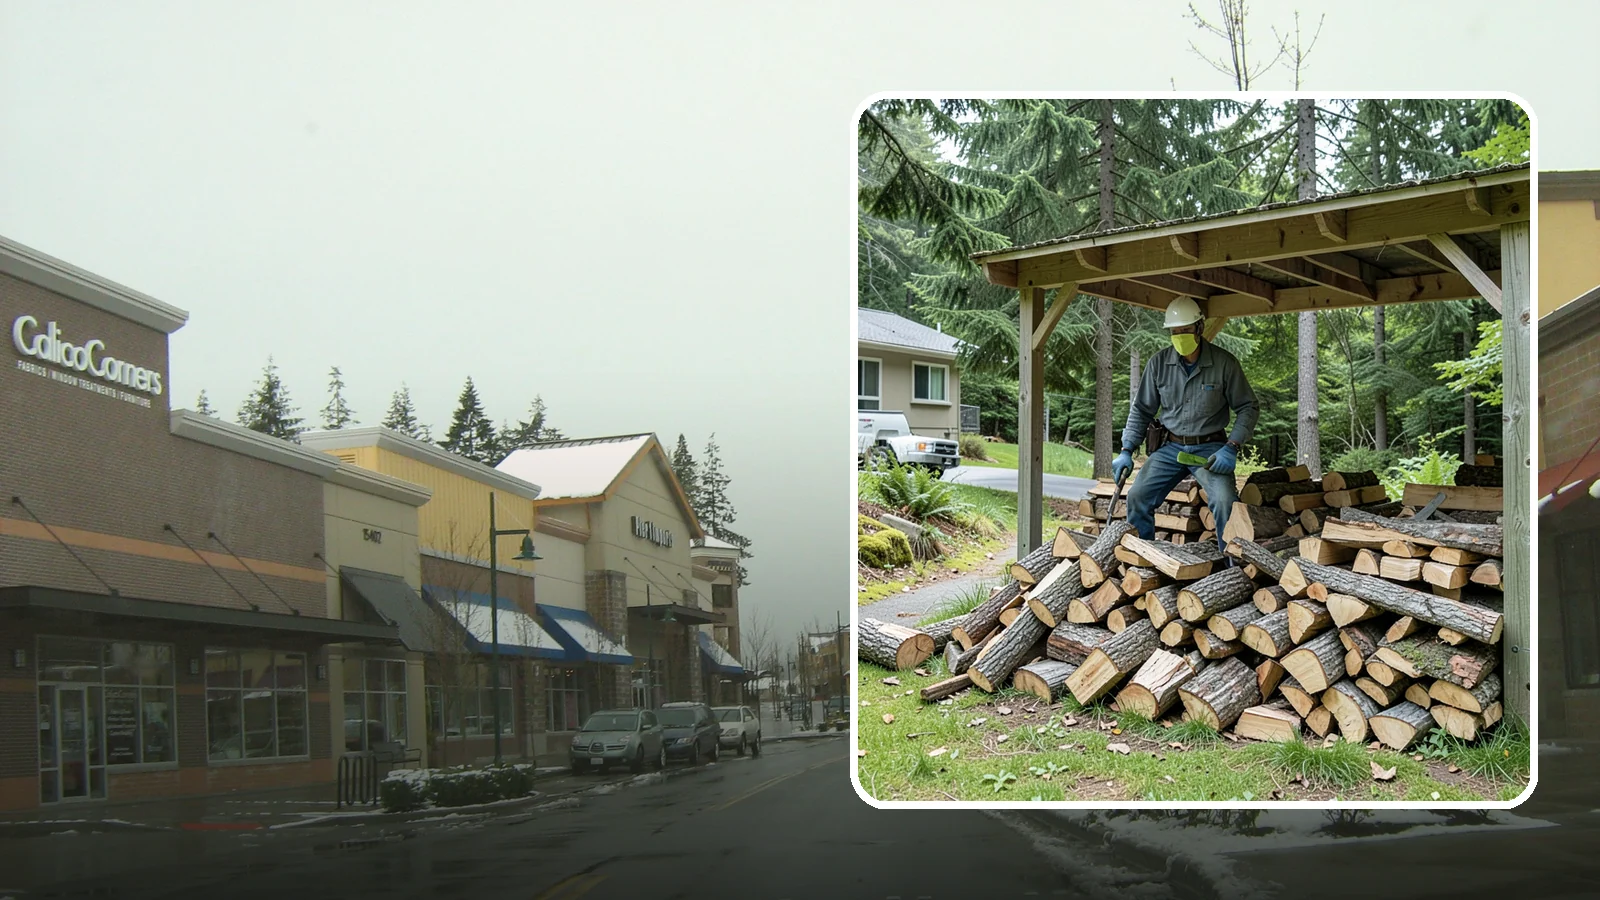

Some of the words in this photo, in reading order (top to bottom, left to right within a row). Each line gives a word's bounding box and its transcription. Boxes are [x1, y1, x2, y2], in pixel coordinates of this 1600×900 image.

[12, 315, 162, 395] CalicoCorners
[17, 359, 47, 378] FABRICS
[51, 370, 78, 387] WINDOW
[78, 378, 117, 399] TREATMENTS
[120, 391, 151, 409] FURNITURE
